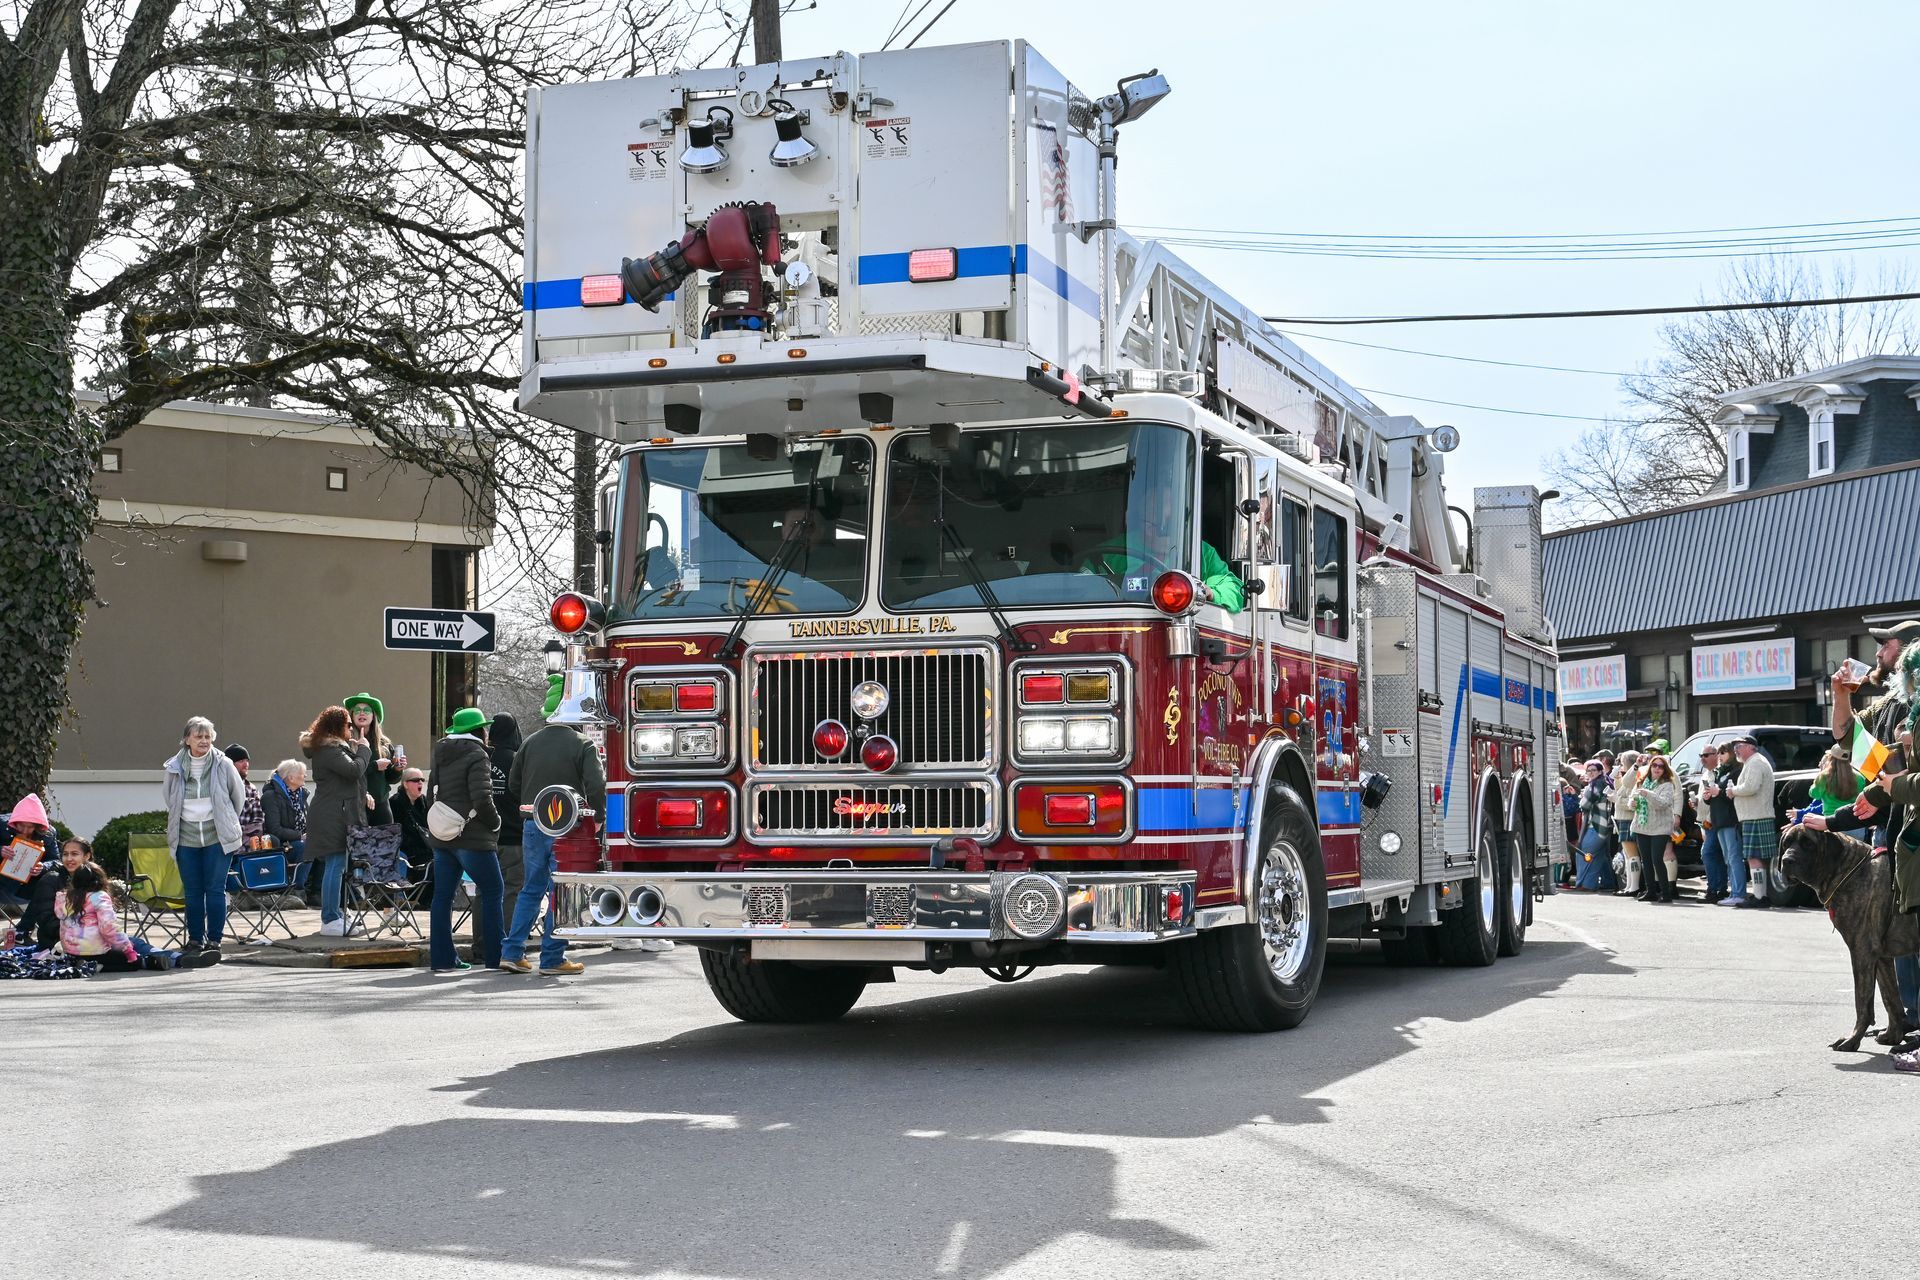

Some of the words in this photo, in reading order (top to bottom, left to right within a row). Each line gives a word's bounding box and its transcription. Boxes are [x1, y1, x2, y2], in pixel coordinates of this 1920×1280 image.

[397, 621, 429, 637] ONE
[434, 622, 464, 639] WAY
[789, 617, 926, 637] TANNERSVILLE,
[929, 616, 957, 633] PA.
[1696, 653, 1720, 679] ELLIE
[1722, 650, 1753, 677] MAE'S
[1755, 646, 1791, 673] CLOSET
[1568, 665, 1593, 689] MAE'S
[1594, 662, 1622, 687] CLOSET
[1198, 670, 1227, 709] POCONO
[1323, 708, 1343, 768] 34
[1217, 743, 1230, 761] FIRE
[833, 797, 907, 821] Seagrave
